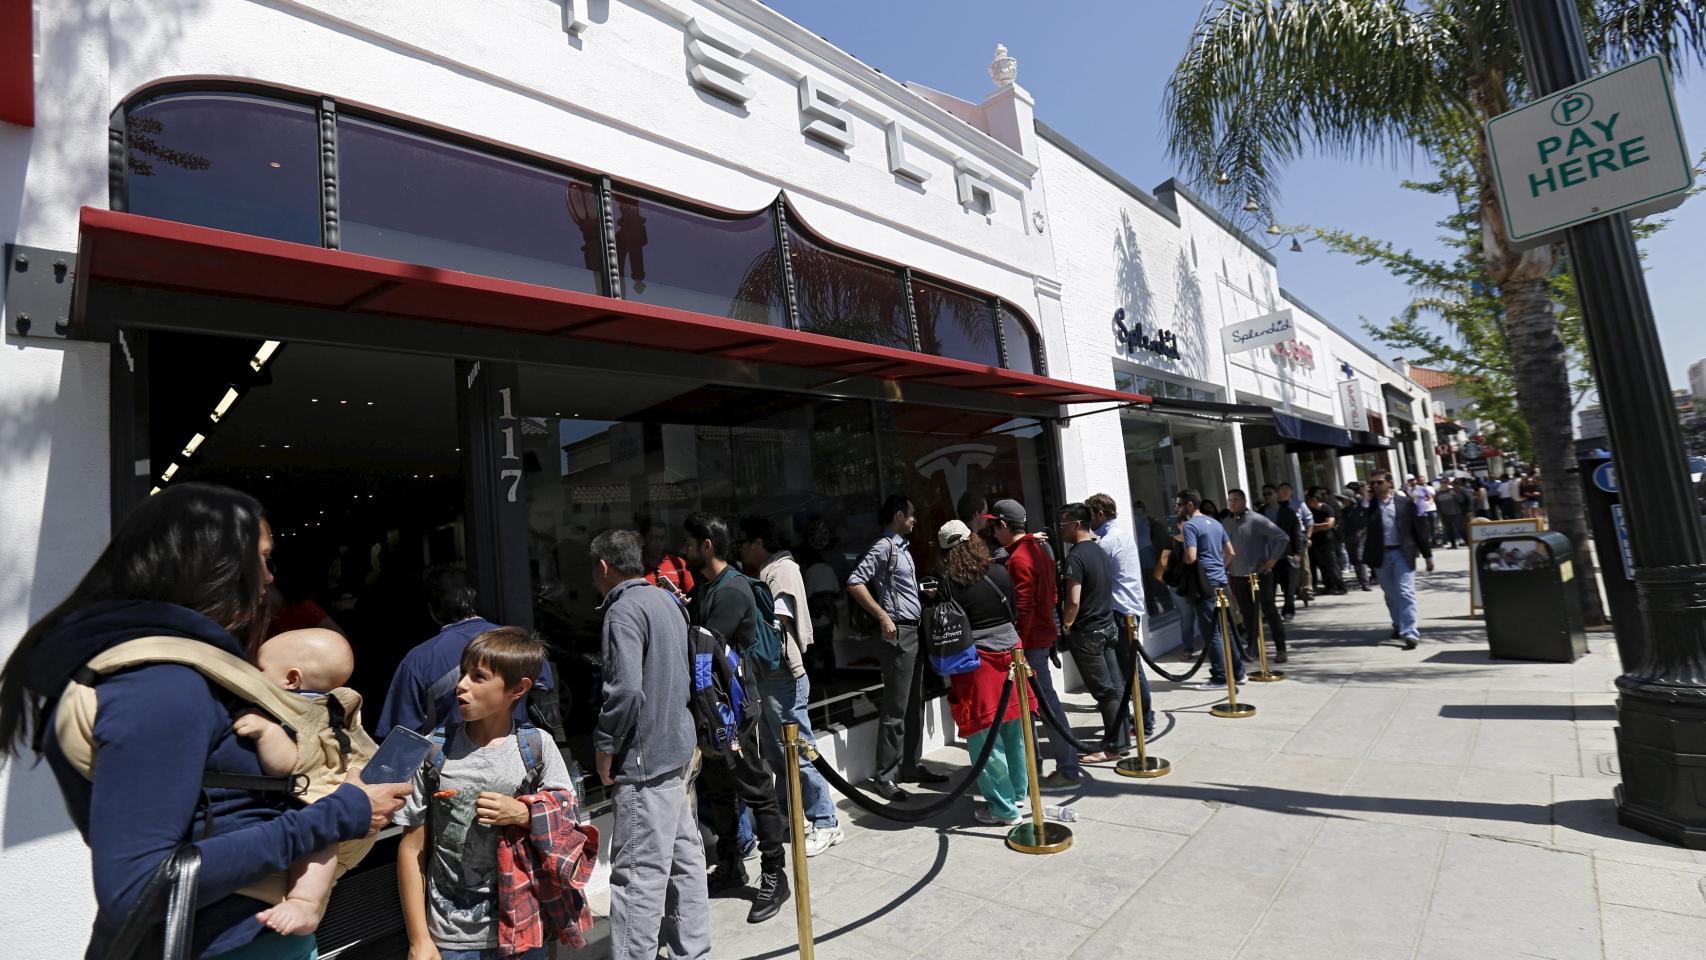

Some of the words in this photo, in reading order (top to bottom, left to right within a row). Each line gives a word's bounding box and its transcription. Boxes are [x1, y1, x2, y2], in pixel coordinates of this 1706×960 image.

[1561, 96, 1585, 122] P
[1537, 112, 1620, 165] PAY
[1528, 136, 1650, 198] HERE
[1232, 318, 1292, 344] Splendid
